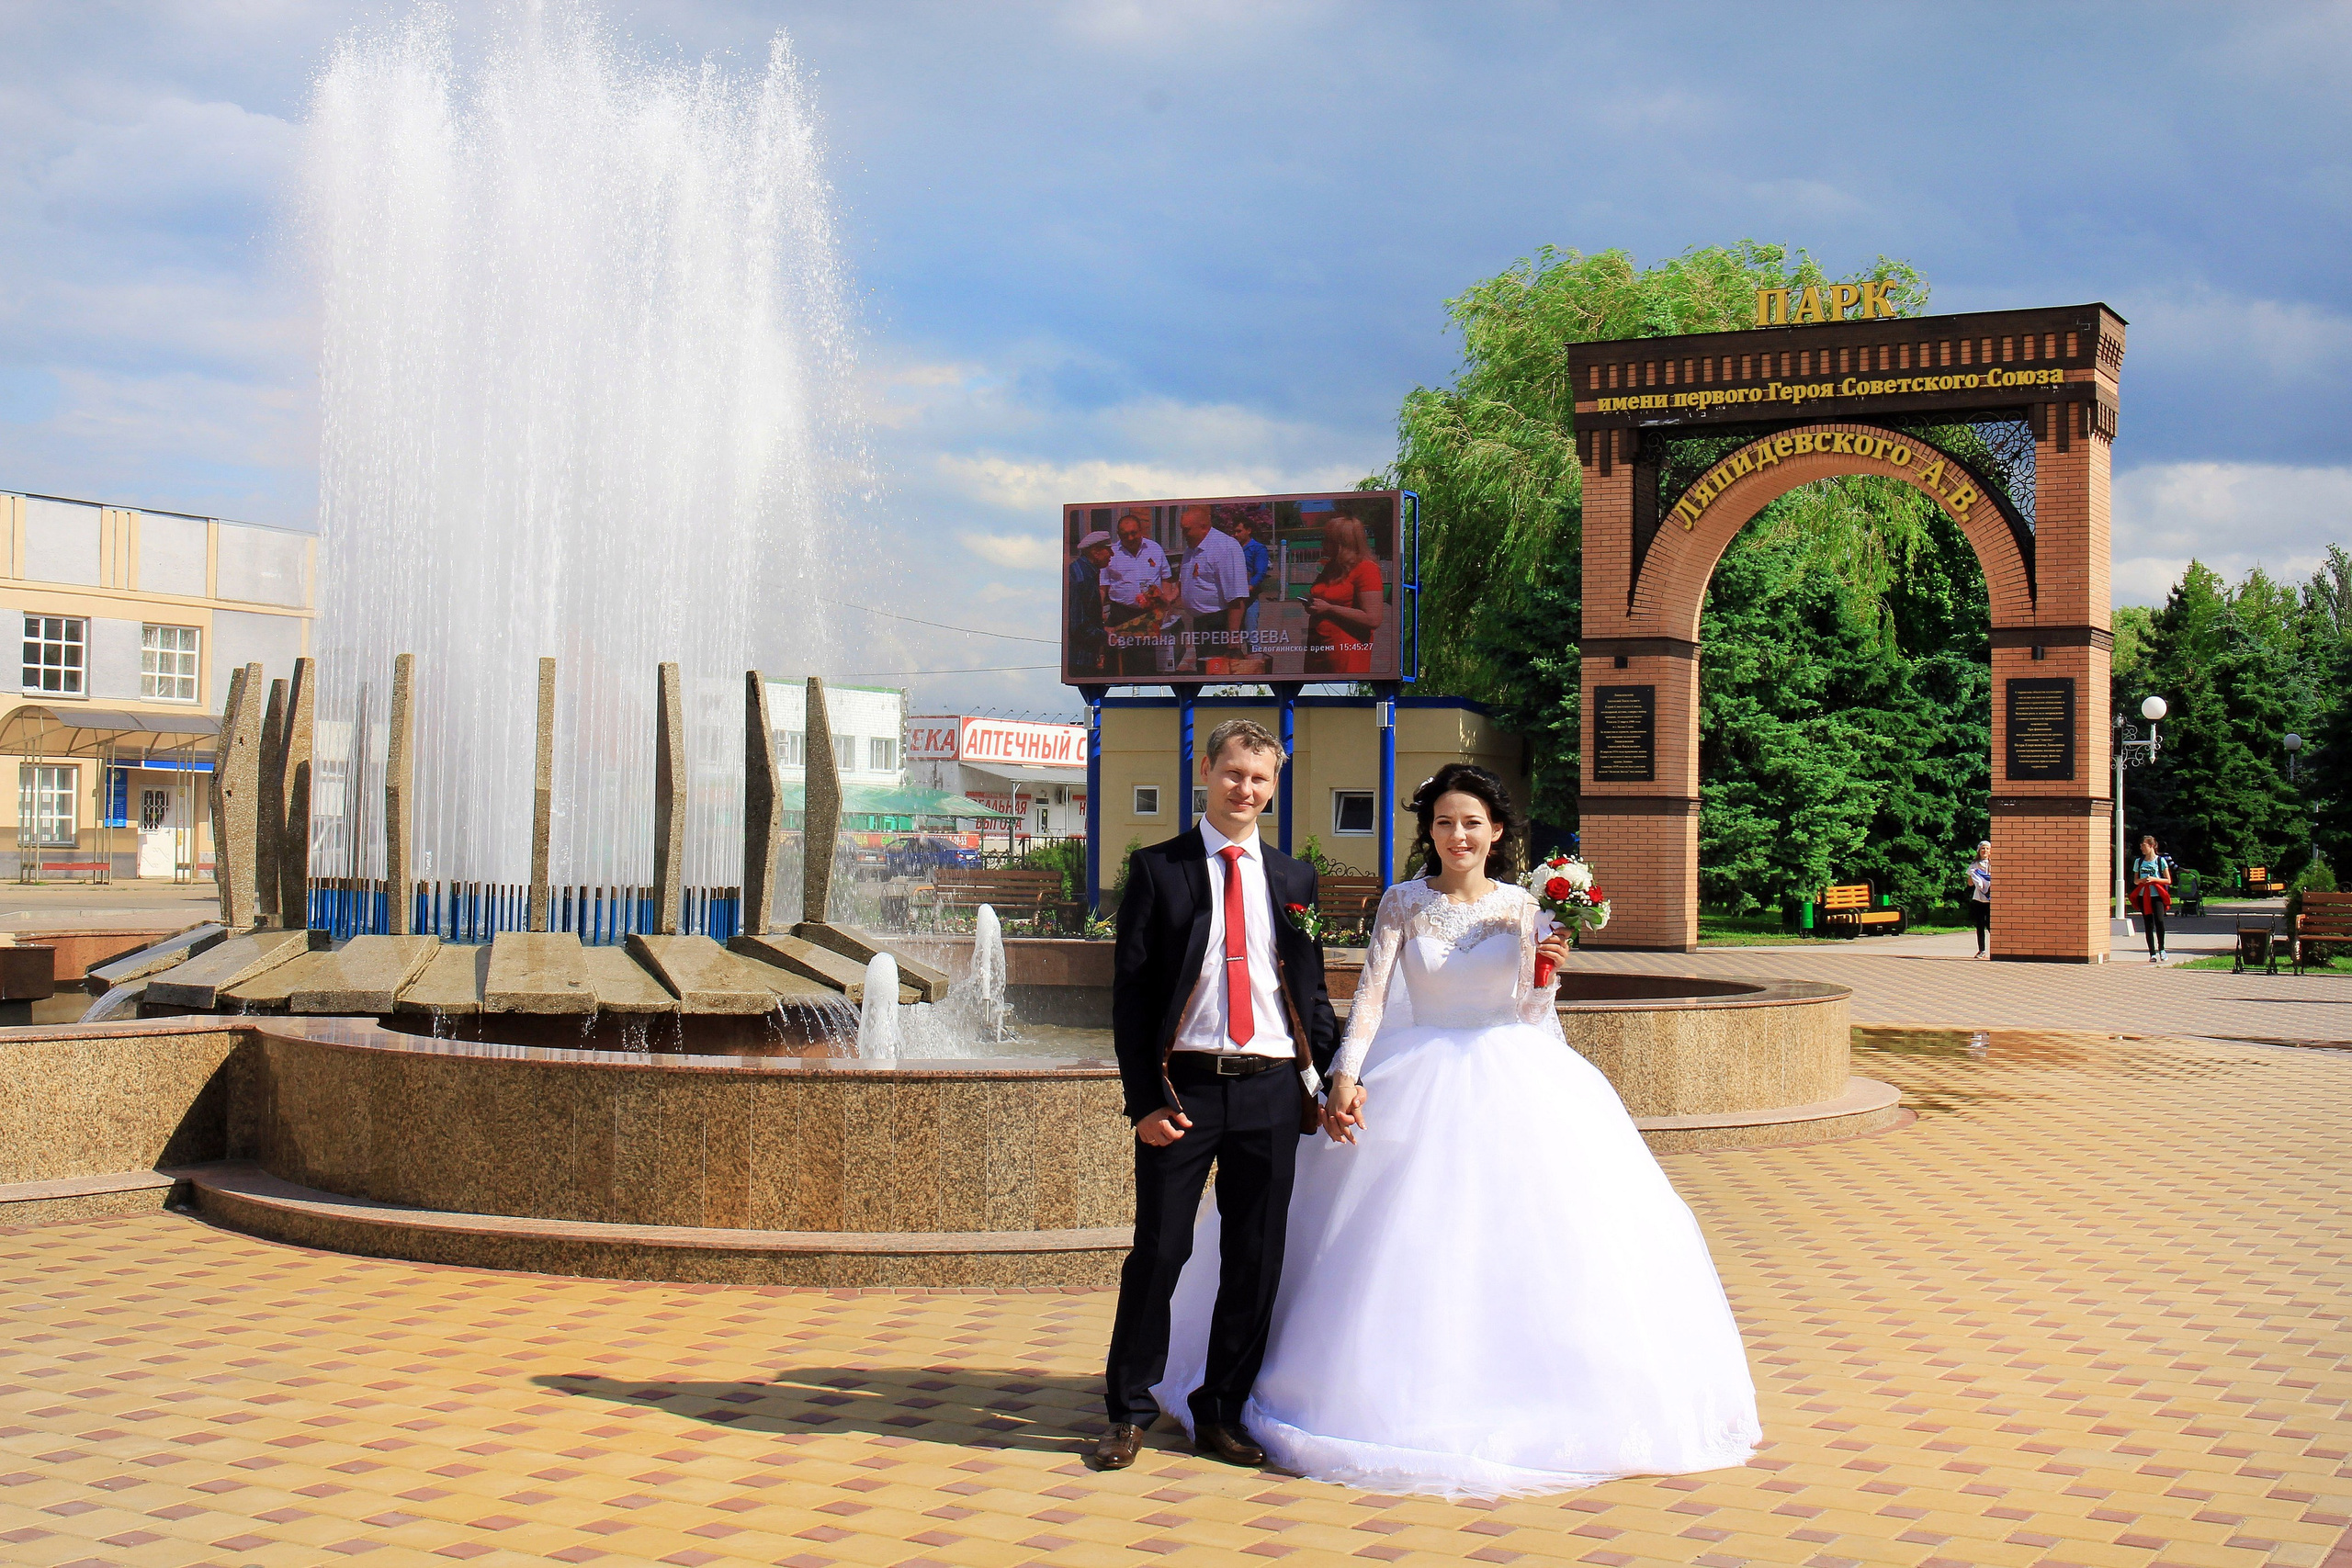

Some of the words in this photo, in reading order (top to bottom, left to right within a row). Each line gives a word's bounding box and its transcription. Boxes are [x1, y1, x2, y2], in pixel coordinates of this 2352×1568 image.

[1755, 278, 1897, 328] ПАРК
[1597, 393, 1668, 413] имени
[1673, 386, 1763, 409] первого
[1768, 379, 1835, 405] Героя
[1841, 372, 1978, 398] Советского
[1986, 367, 2065, 388] Союза
[1673, 432, 1913, 531] Ляпидевского
[1917, 458, 1980, 524] А.В.
[1108, 633, 1176, 648] Светлана
[1181, 629, 1290, 646] ПЕРЕВЕРЗЕВА
[1251, 644, 1308, 653] Белоглинское
[1310, 645, 1335, 654] время
[1340, 642, 1374, 652] 15:45:27
[906, 728, 956, 751] ЕКА
[966, 728, 1071, 761] АПТЕЧНЫЙ
